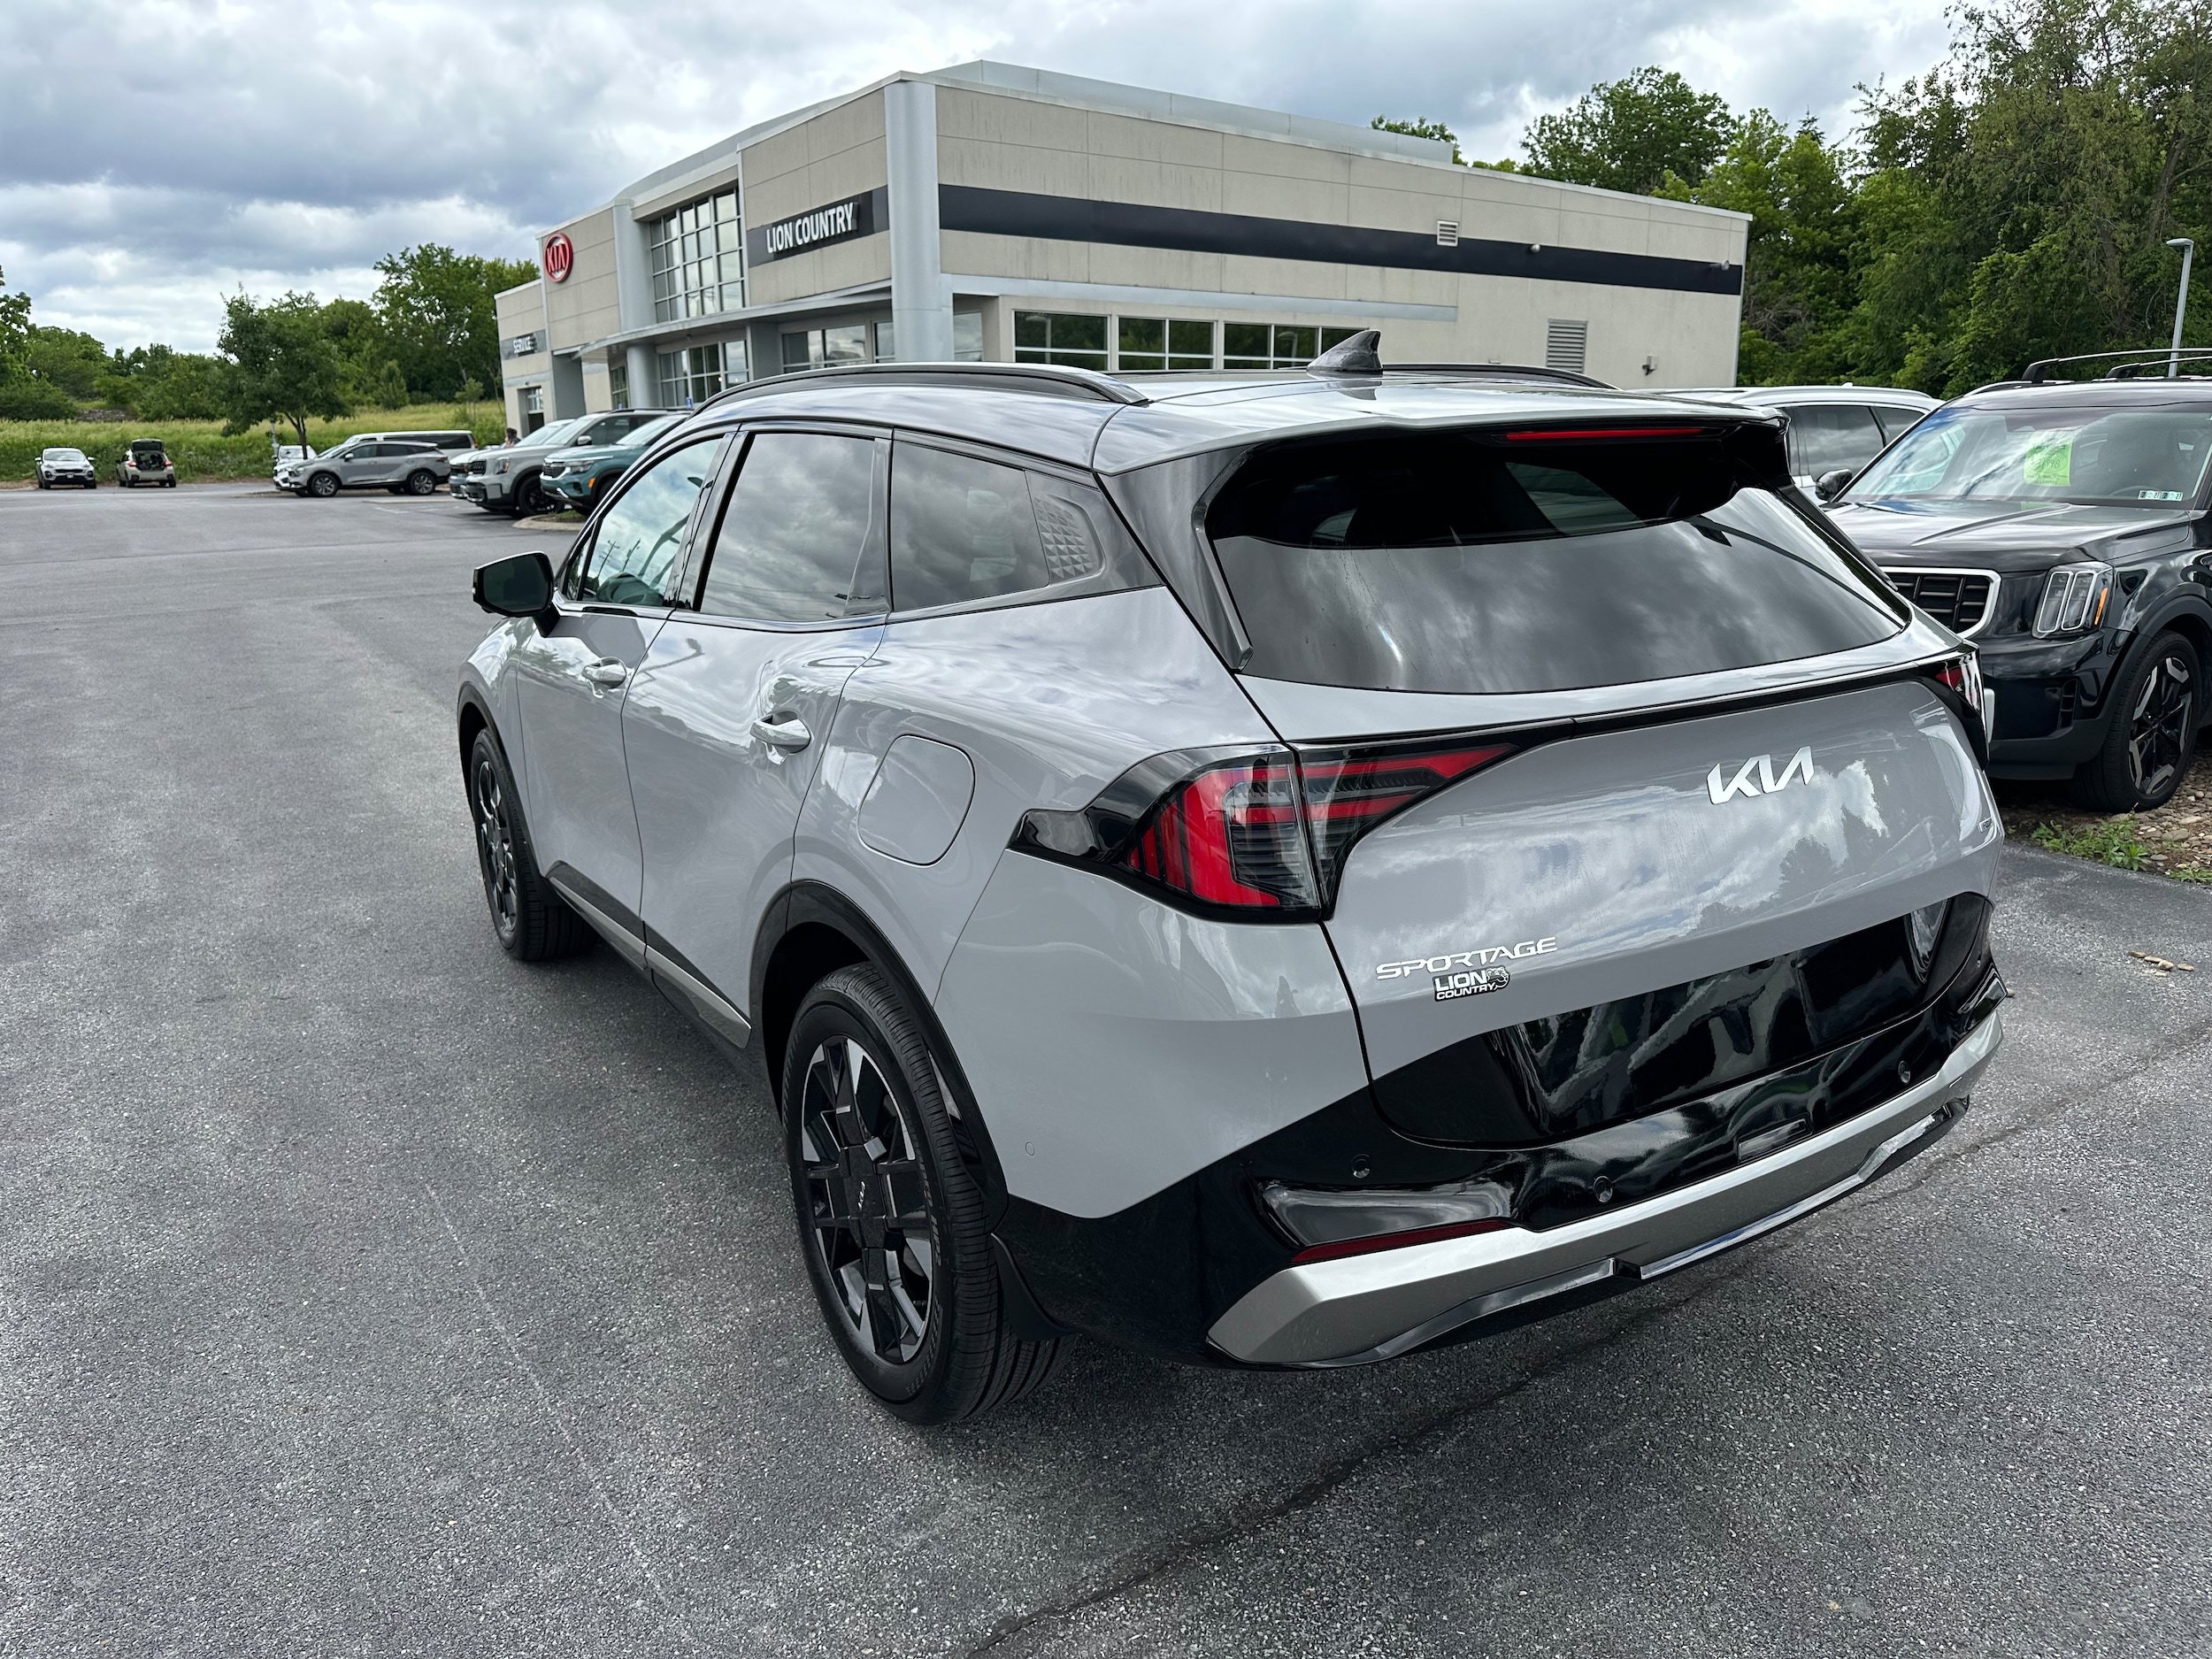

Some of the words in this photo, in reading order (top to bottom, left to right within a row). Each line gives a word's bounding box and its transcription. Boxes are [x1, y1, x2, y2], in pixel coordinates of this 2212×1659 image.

[767, 221, 794, 254] LION
[795, 202, 854, 245] COUNTRY
[546, 243, 567, 273] KIA
[1707, 746, 1814, 804] KIA
[1376, 937, 1558, 979] SPORTAGE
[1434, 969, 1487, 992] LION
[1436, 982, 1496, 1000] COUNTRY
